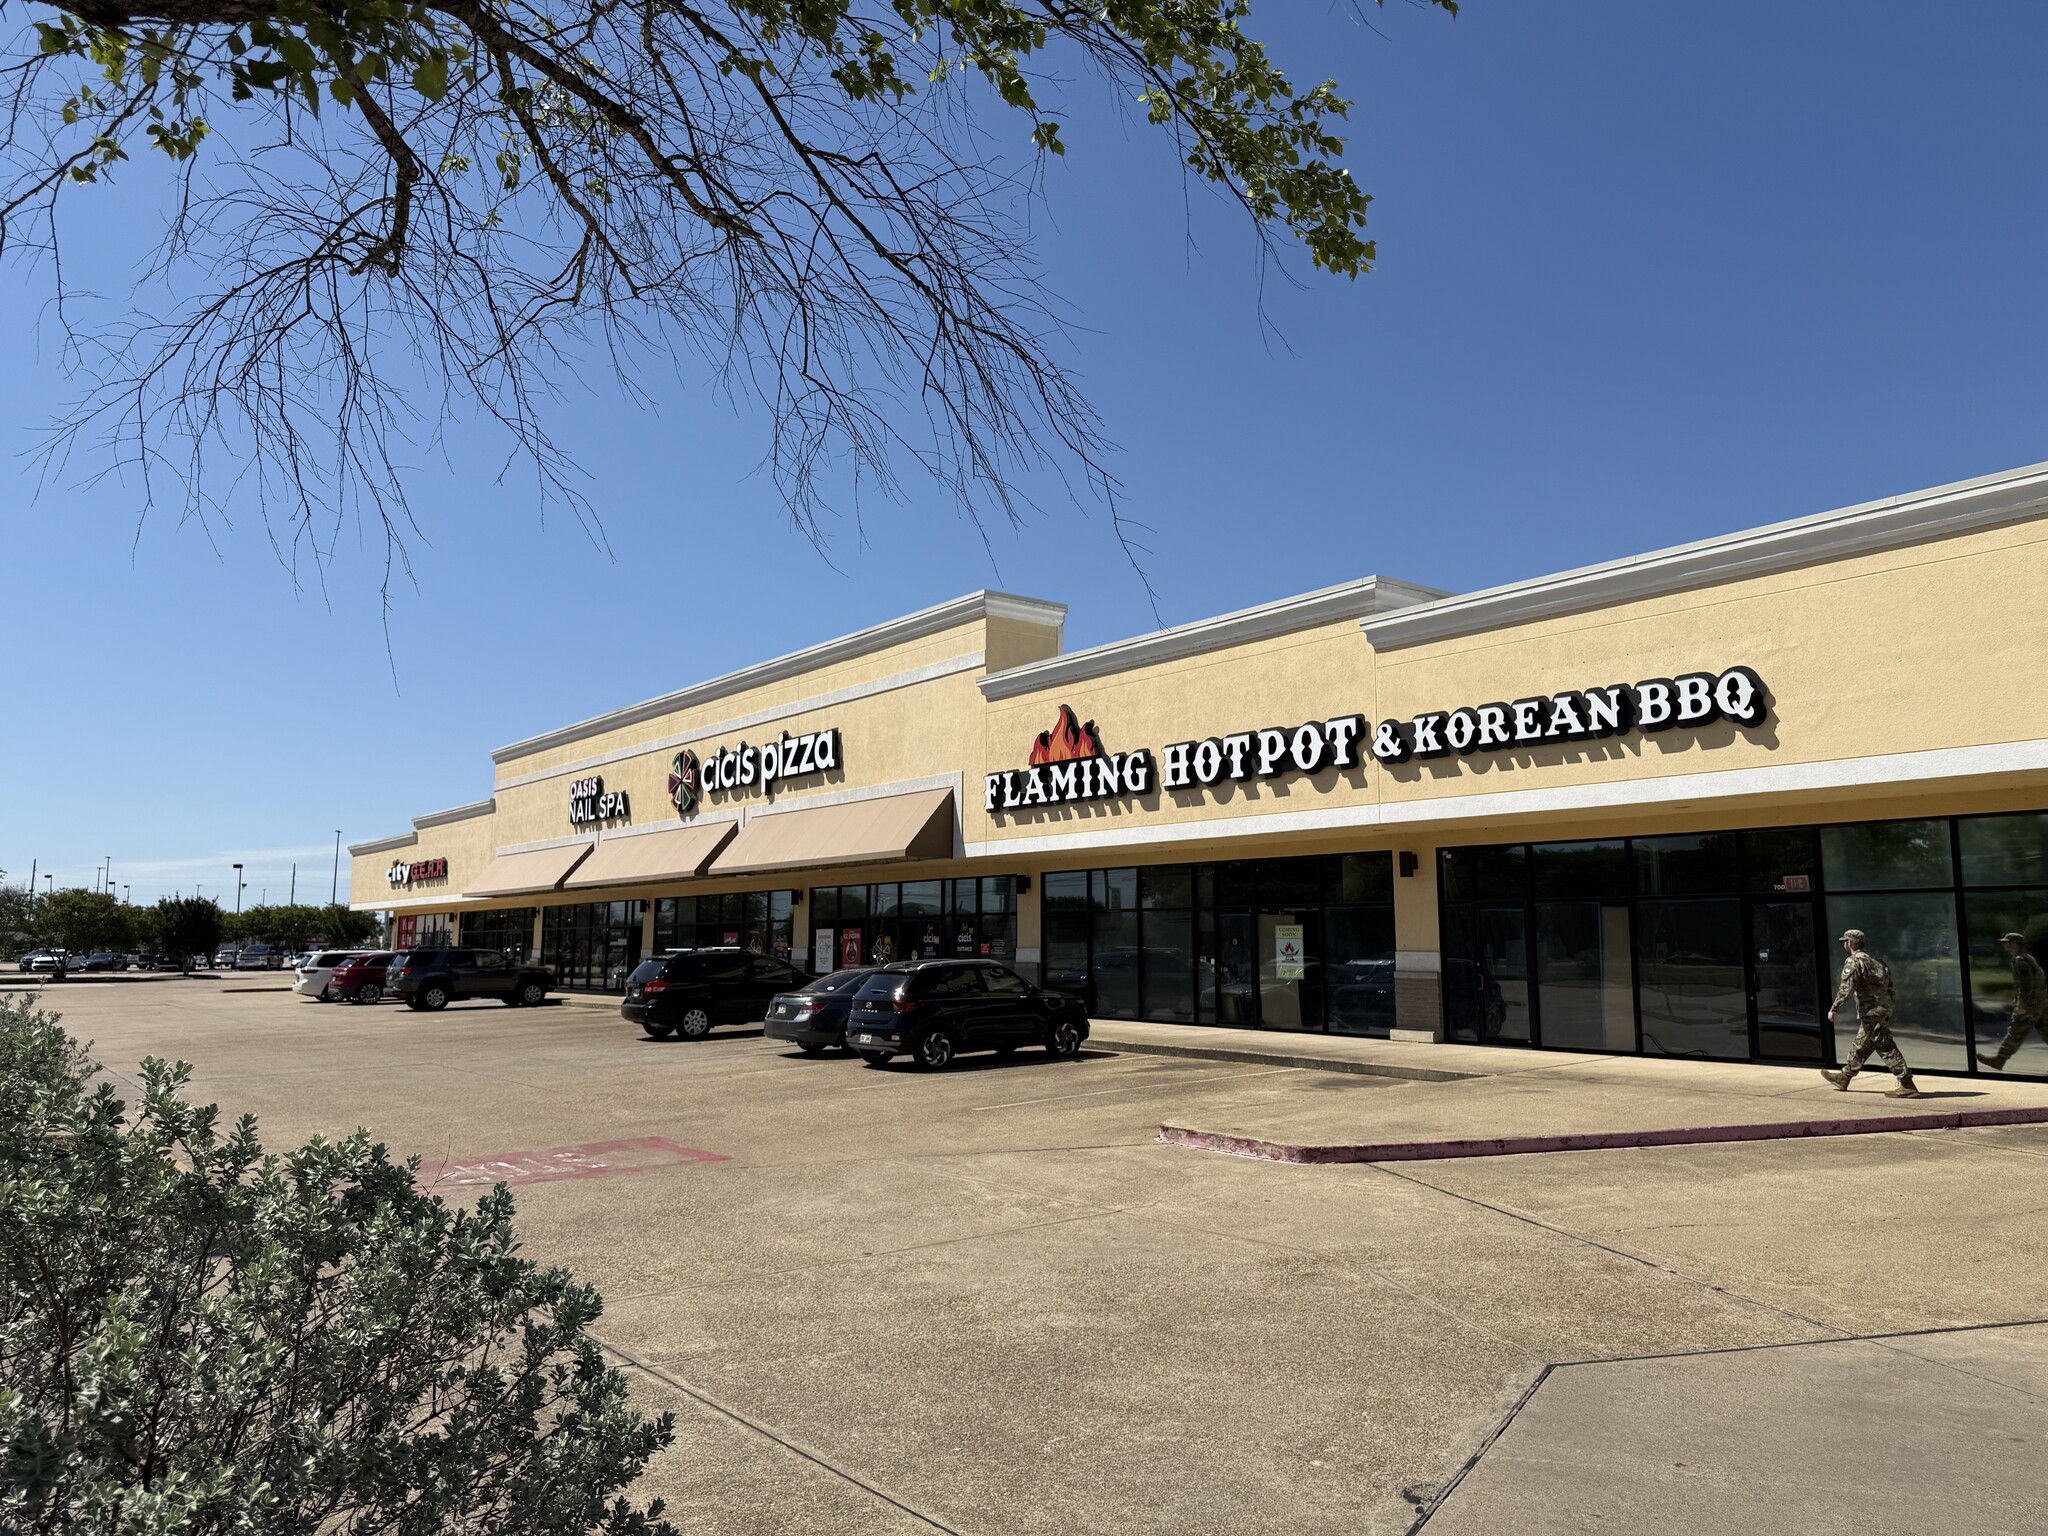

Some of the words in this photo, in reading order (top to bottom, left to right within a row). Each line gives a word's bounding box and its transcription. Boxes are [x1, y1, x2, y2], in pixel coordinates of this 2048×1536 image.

[984, 750, 1150, 812] FLAMING
[1162, 716, 1360, 788] HOTPOT
[1372, 723, 1403, 758] &
[1413, 688, 1622, 754] KOREAN
[1637, 670, 1758, 727] BBQ
[701, 742, 756, 792] cicis
[761, 728, 836, 793] pizza
[570, 777, 599, 800] OASIS
[569, 798, 596, 823] NAIL
[599, 792, 625, 819] SPA
[385, 860, 411, 884] city
[957, 933, 972, 943] cicis
